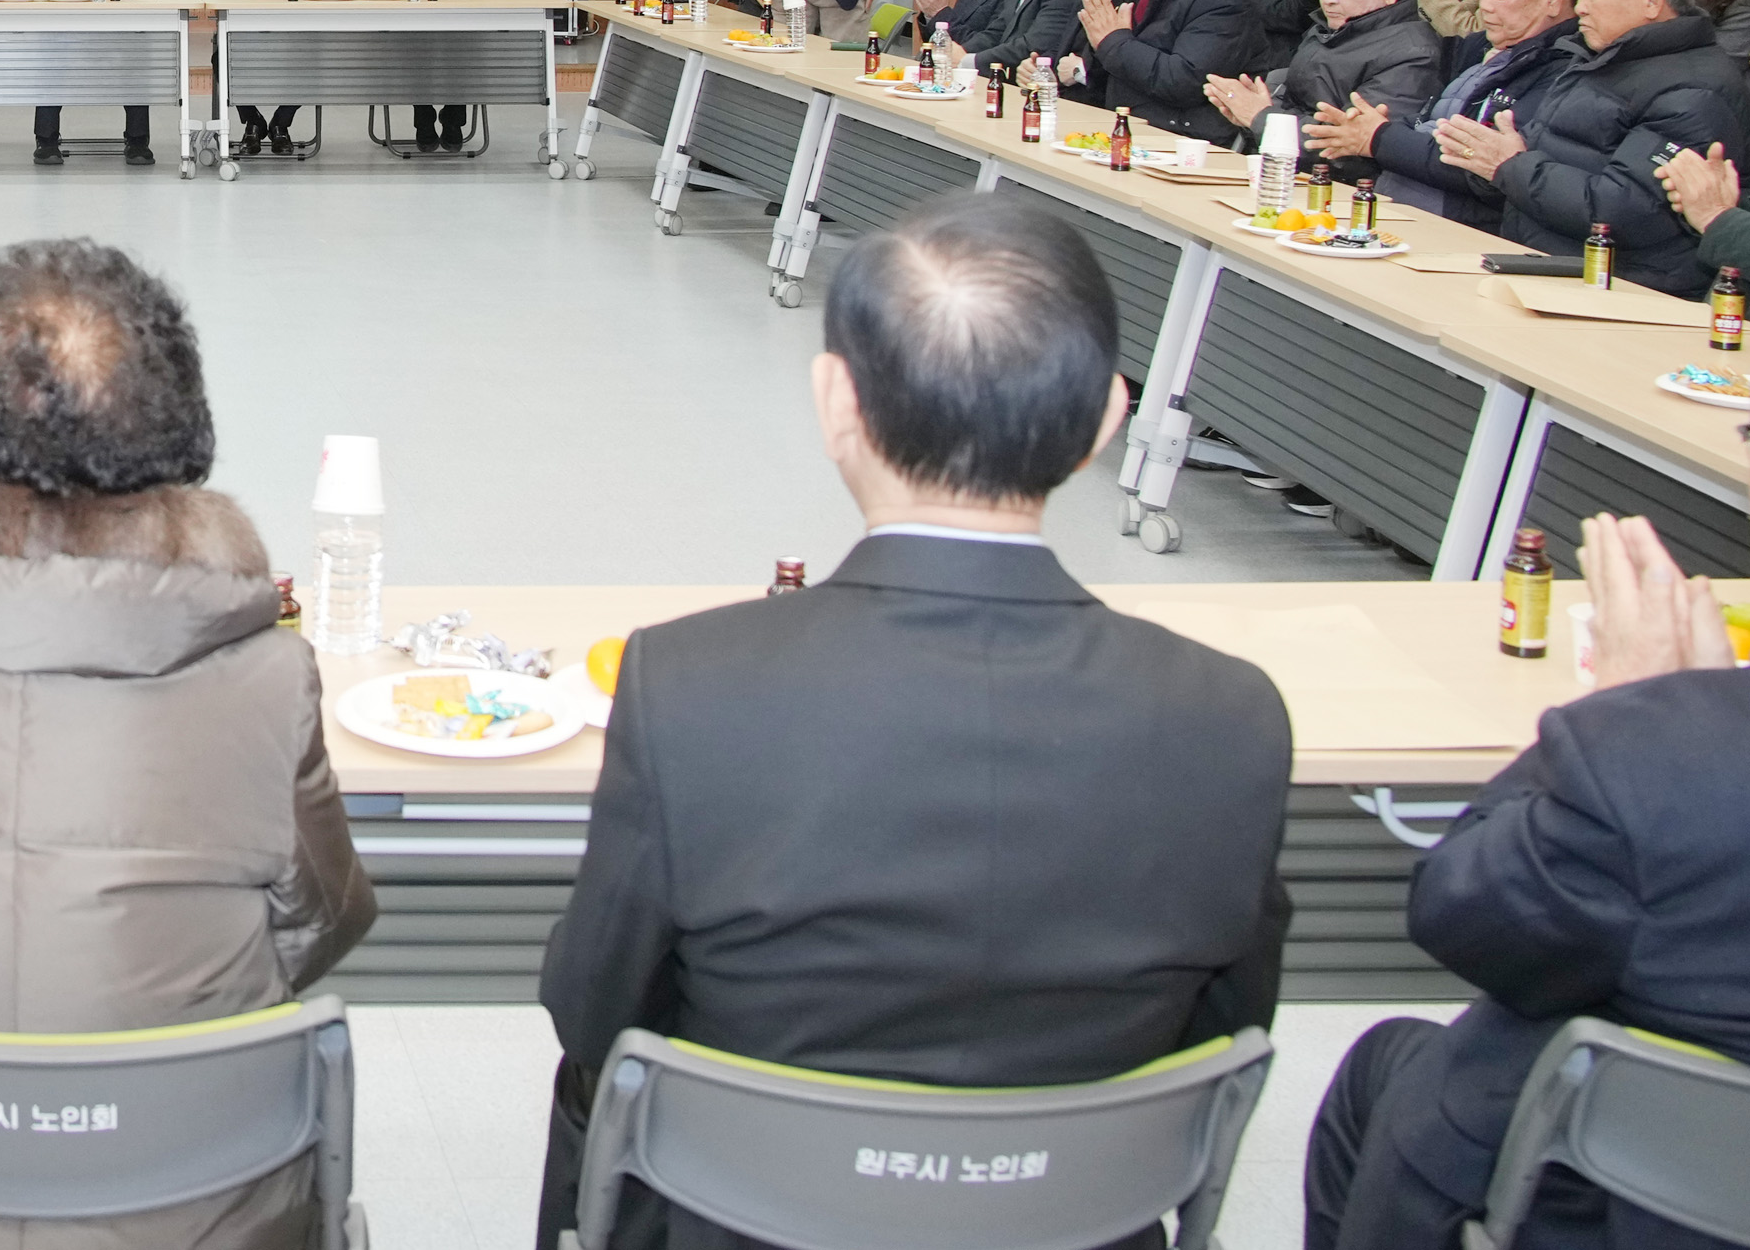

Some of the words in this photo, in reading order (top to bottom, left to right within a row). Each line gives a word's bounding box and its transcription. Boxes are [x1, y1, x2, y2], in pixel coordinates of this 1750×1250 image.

[30, 1102, 119, 1132] 노인회
[854, 1146, 950, 1182] 원주시
[958, 1150, 1049, 1182] 노인회
